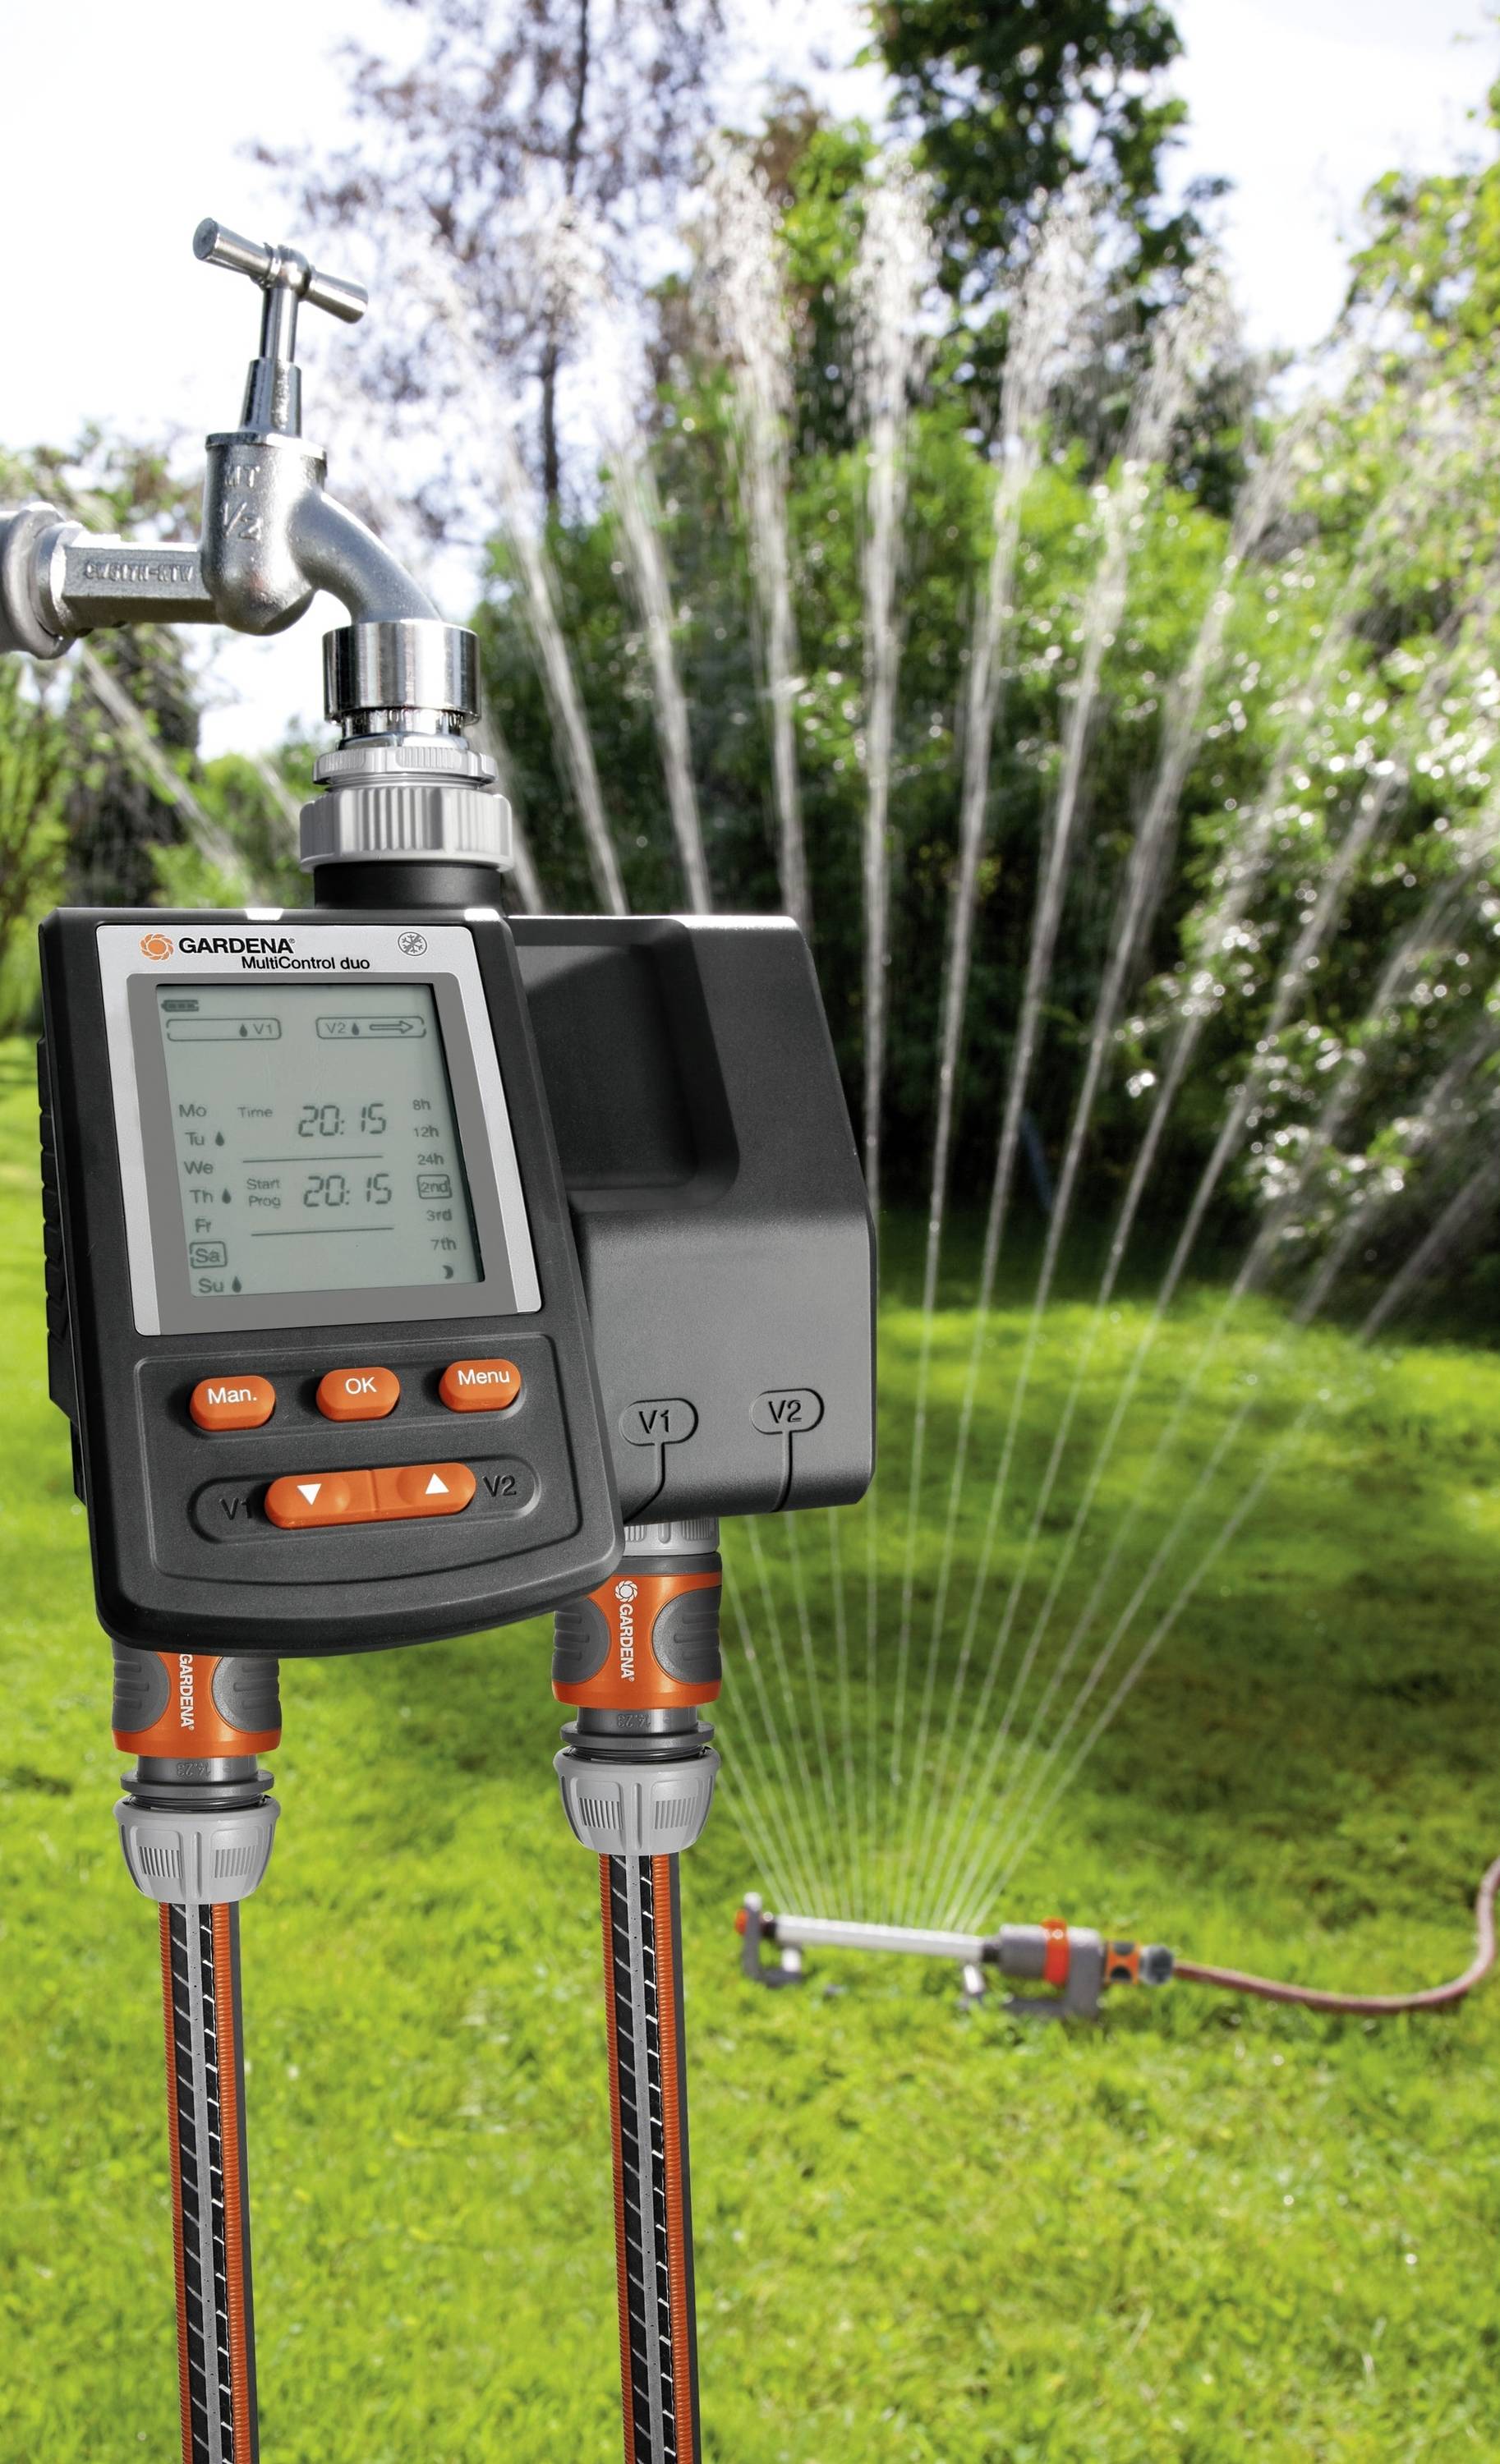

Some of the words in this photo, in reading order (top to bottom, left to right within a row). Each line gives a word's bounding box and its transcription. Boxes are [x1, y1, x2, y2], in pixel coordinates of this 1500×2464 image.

[242, 956, 335, 970] MultiControl
[340, 958, 370, 970] duo
[253, 1023, 274, 1035] V1
[325, 1023, 346, 1034] V2
[178, 1104, 207, 1118] Mo
[412, 1098, 431, 1110] 8h
[237, 1106, 274, 1118] Time
[414, 1125, 439, 1138] 12h
[184, 1132, 205, 1146] Tu
[417, 1152, 444, 1165] 24h
[183, 1161, 214, 1175] We
[246, 1178, 280, 1190] Start
[421, 1180, 449, 1193] 2nd
[189, 1188, 214, 1203] Th
[248, 1195, 281, 1208] Prog
[426, 1208, 453, 1221] 3rd
[195, 1218, 212, 1233] Fr
[430, 1236, 457, 1250] 7th
[195, 1248, 221, 1263] Sa
[198, 1278, 224, 1294] Su
[458, 1368, 511, 1386] Menu
[344, 1377, 377, 1395] OK
[207, 1386, 258, 1405] Man.
[768, 1399, 803, 1423] V2
[638, 1409, 669, 1434] V1
[481, 1475, 518, 1498] V2
[219, 1497, 252, 1520] V1
